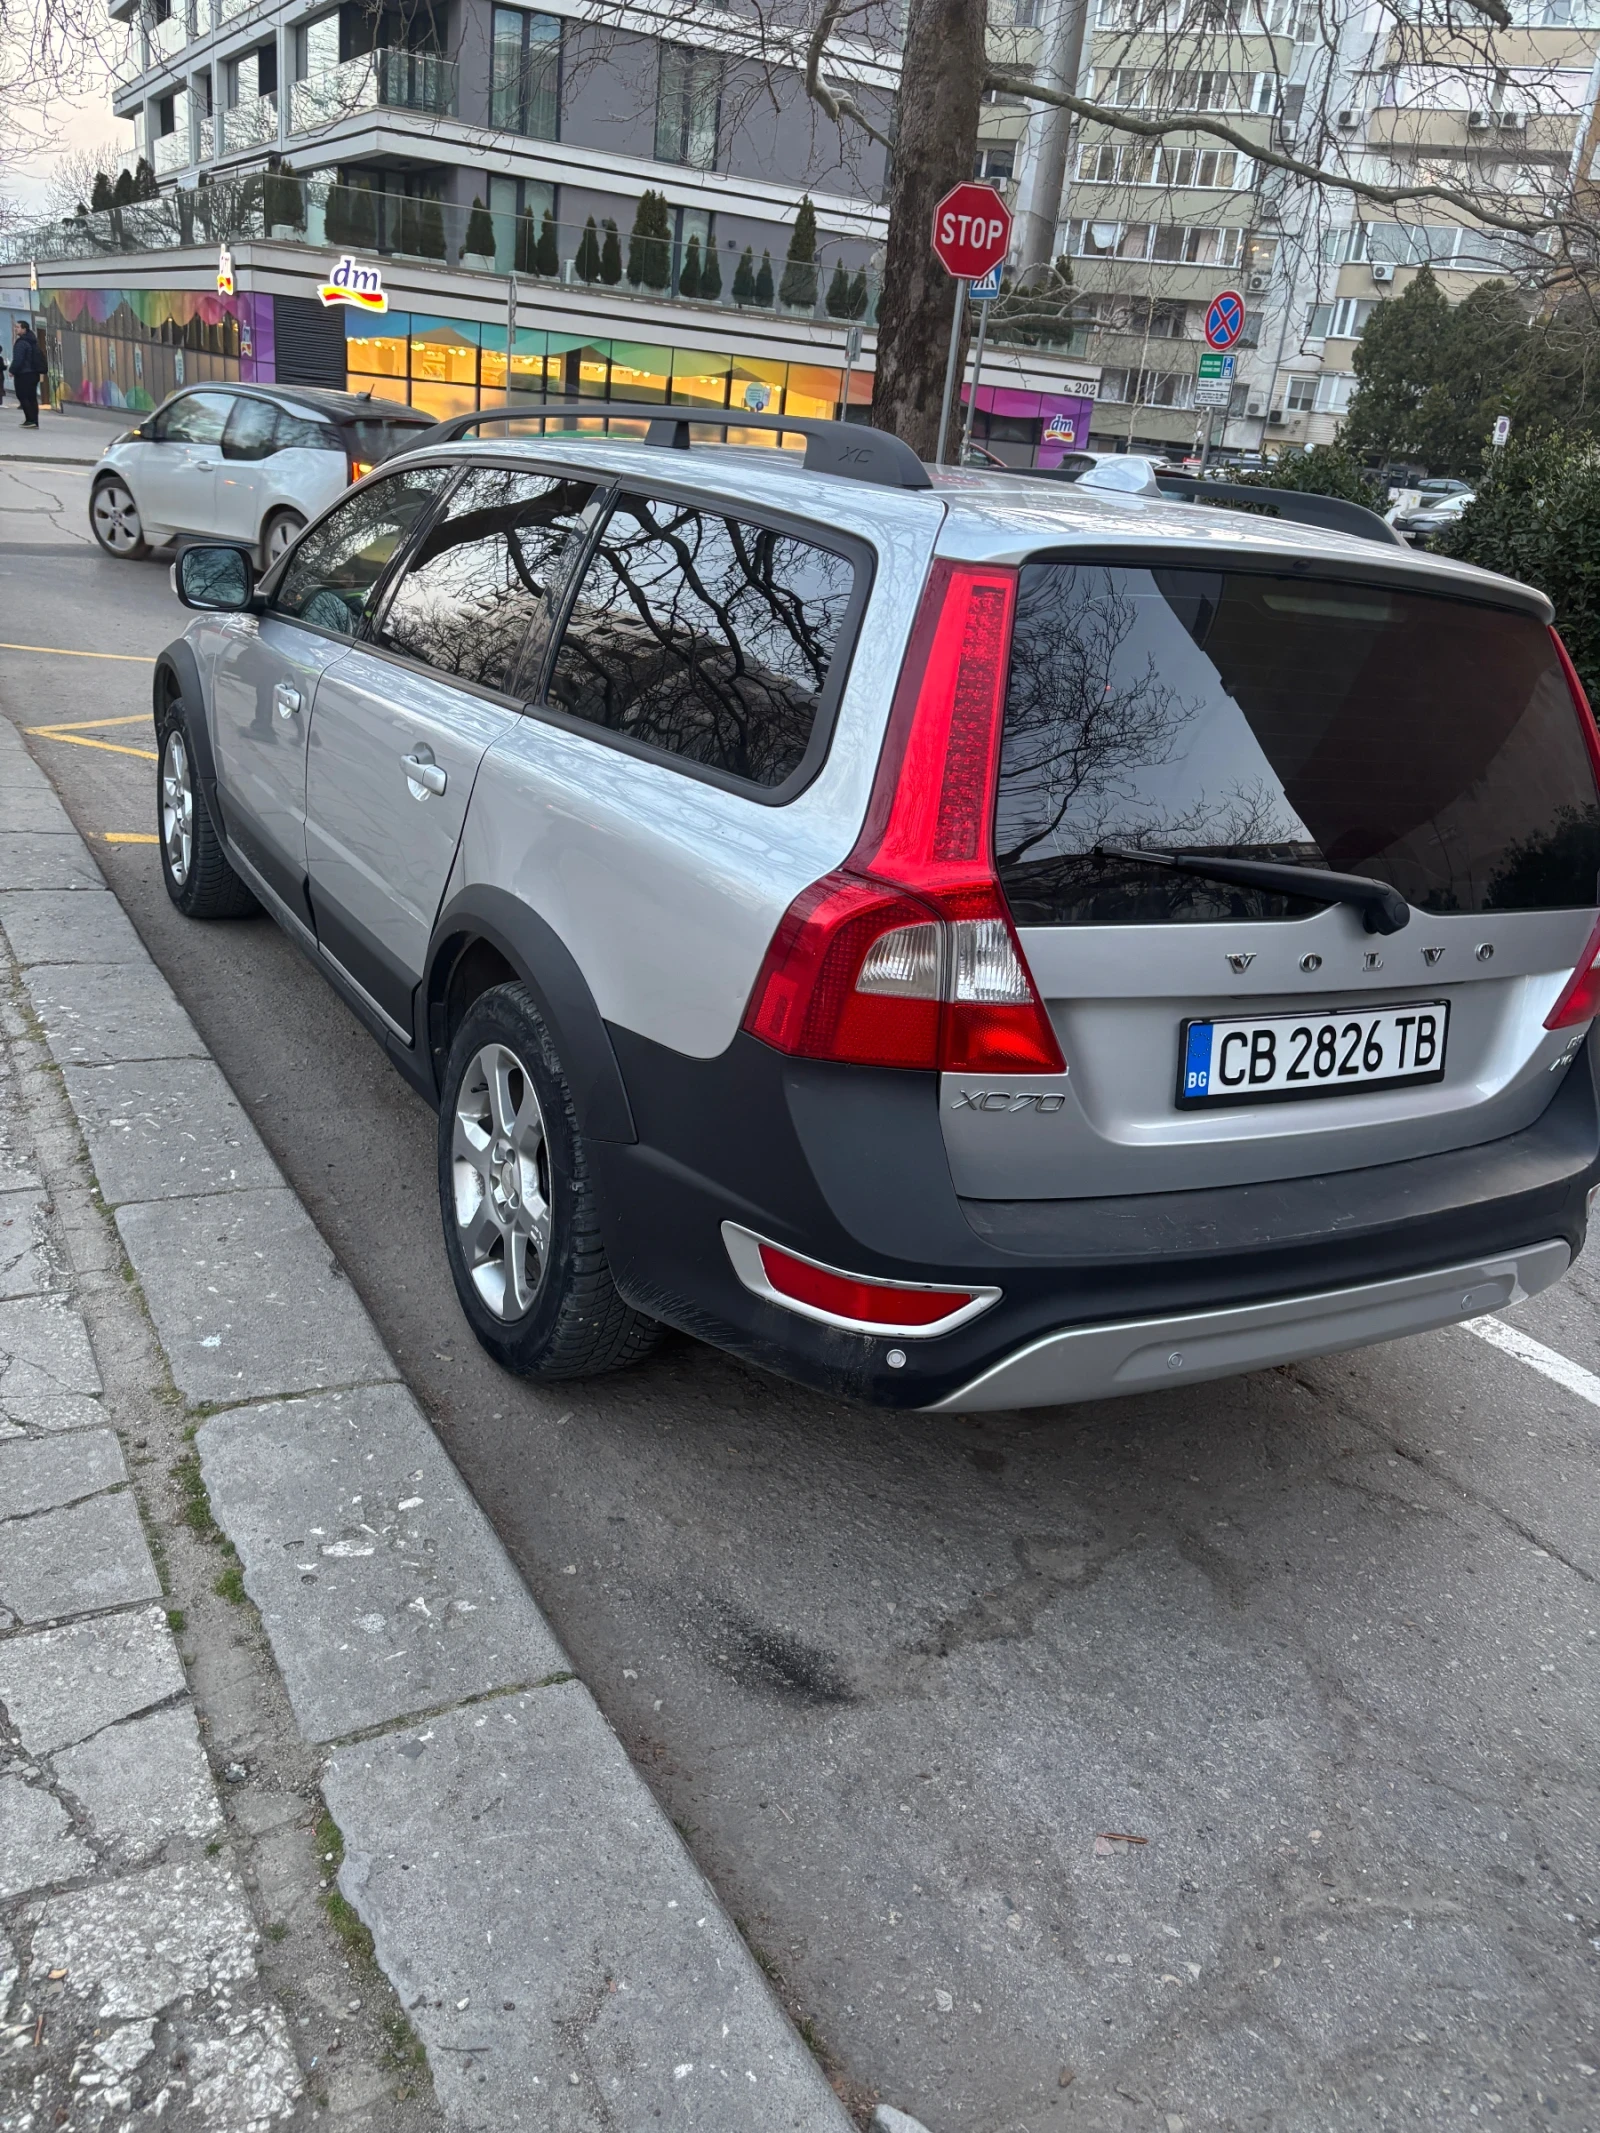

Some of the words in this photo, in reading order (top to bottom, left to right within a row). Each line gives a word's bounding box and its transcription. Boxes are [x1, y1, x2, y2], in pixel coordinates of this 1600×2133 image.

[941, 212, 1003, 250] STOP
[333, 260, 378, 291] dm
[1074, 382, 1097, 395] 202
[1051, 415, 1072, 432] dm
[838, 447, 874, 463] XC
[1225, 942, 1495, 975] VOLVO
[1219, 1029, 1277, 1087] CB
[1286, 1020, 1382, 1082] 2826
[1395, 1015, 1437, 1069] TB
[1188, 1071, 1207, 1089] BG
[951, 1089, 1066, 1113] XC70
